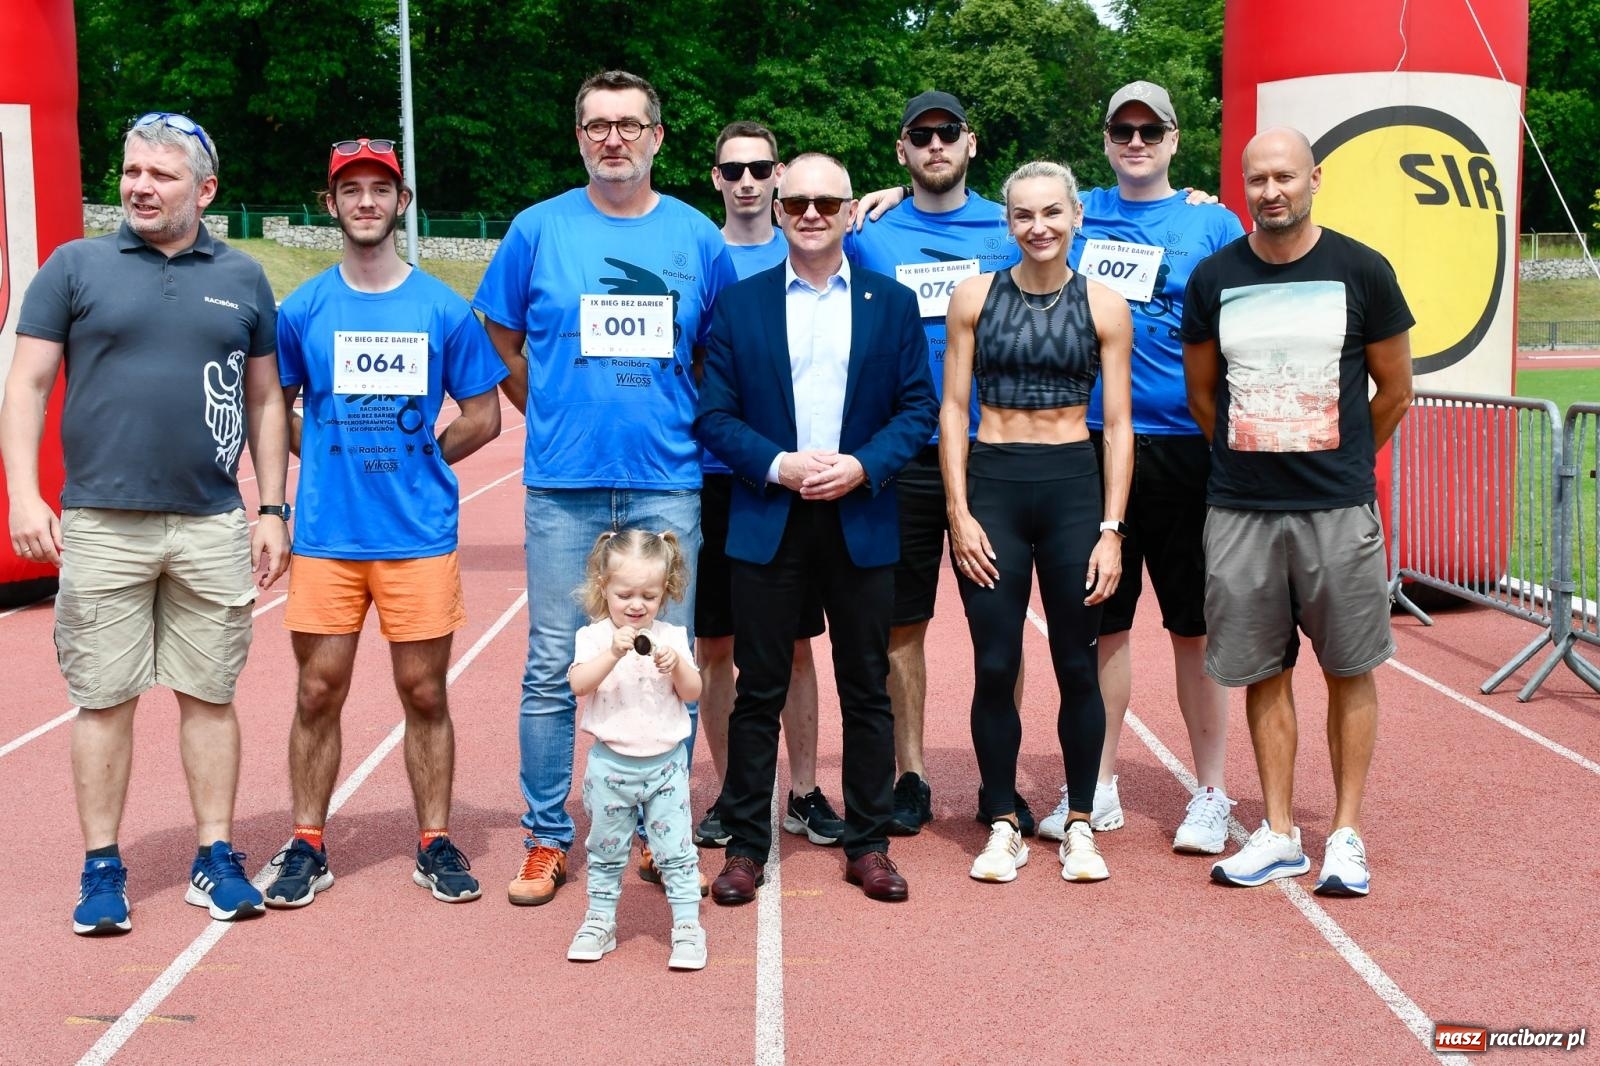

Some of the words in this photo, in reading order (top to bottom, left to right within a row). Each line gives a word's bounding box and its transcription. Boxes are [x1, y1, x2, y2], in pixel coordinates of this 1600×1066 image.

[1399, 154, 1504, 212] SIR
[1131, 248, 1155, 256] BARIER
[662, 269, 696, 282] Racibórz
[1097, 259, 1138, 279] 007
[604, 316, 646, 336] 001
[356, 354, 405, 372] 064
[612, 359, 650, 368] Racibórz
[616, 372, 652, 385] Wikoss
[358, 446, 396, 454] Racibórz
